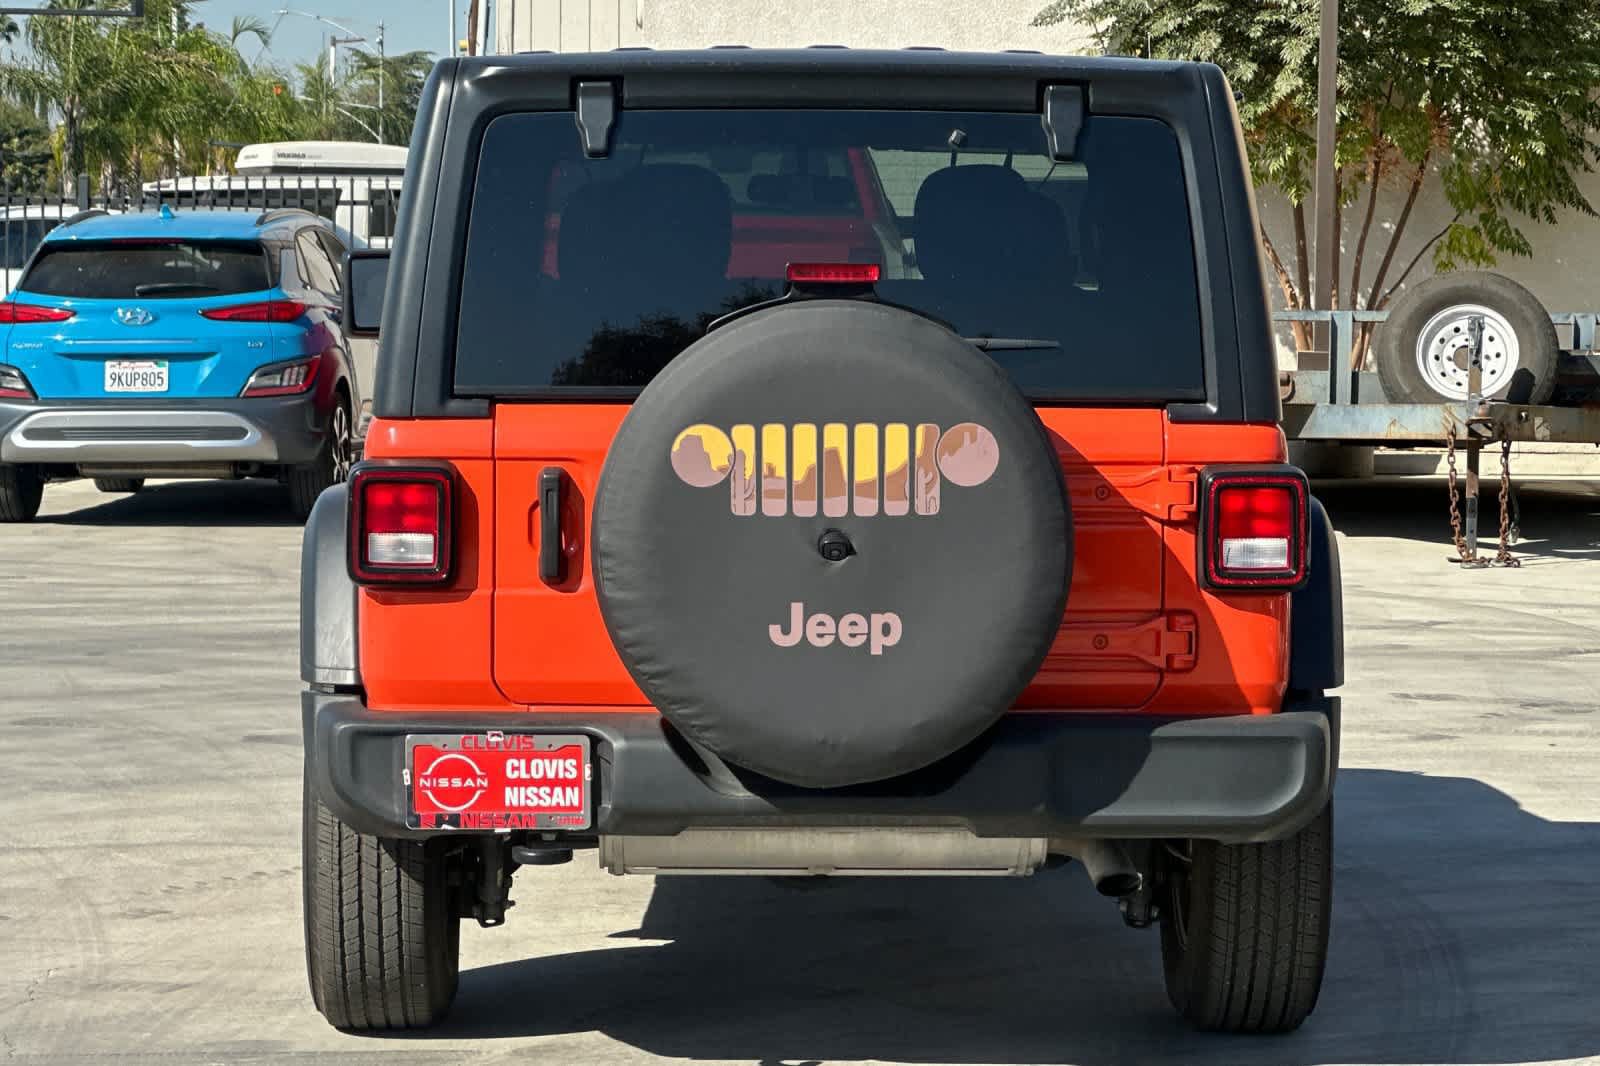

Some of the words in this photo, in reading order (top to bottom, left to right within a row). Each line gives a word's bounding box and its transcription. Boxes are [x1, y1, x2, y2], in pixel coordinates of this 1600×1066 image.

[110, 371, 164, 387] 9KUP805
[768, 602, 902, 655] Jeep
[460, 735, 534, 750] CLOVIS
[505, 758, 577, 779] CLOVIS
[419, 777, 488, 787] NISSAN
[504, 786, 579, 807] NISSAN
[460, 813, 537, 829] NISSAN
